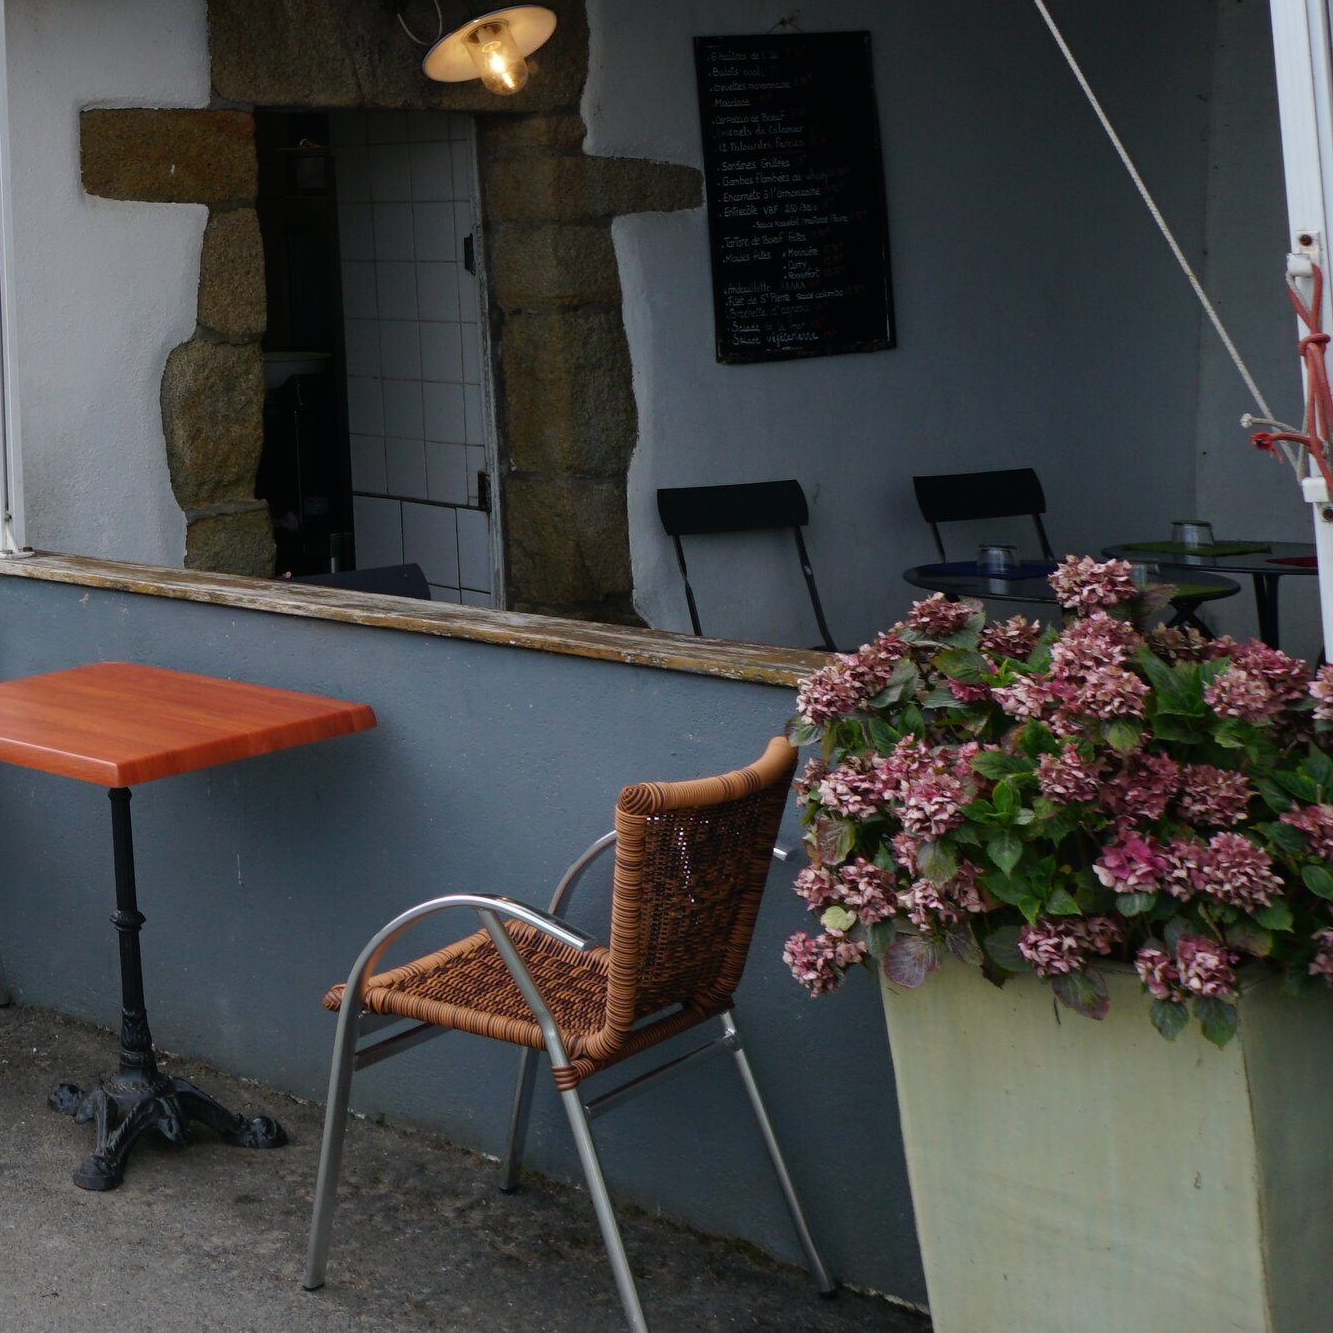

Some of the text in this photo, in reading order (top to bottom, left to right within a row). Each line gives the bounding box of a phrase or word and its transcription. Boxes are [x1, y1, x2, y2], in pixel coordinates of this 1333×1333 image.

[722, 160, 756, 171] Sardines
[723, 175, 754, 187] Gambas
[723, 188, 760, 203] Encornets
